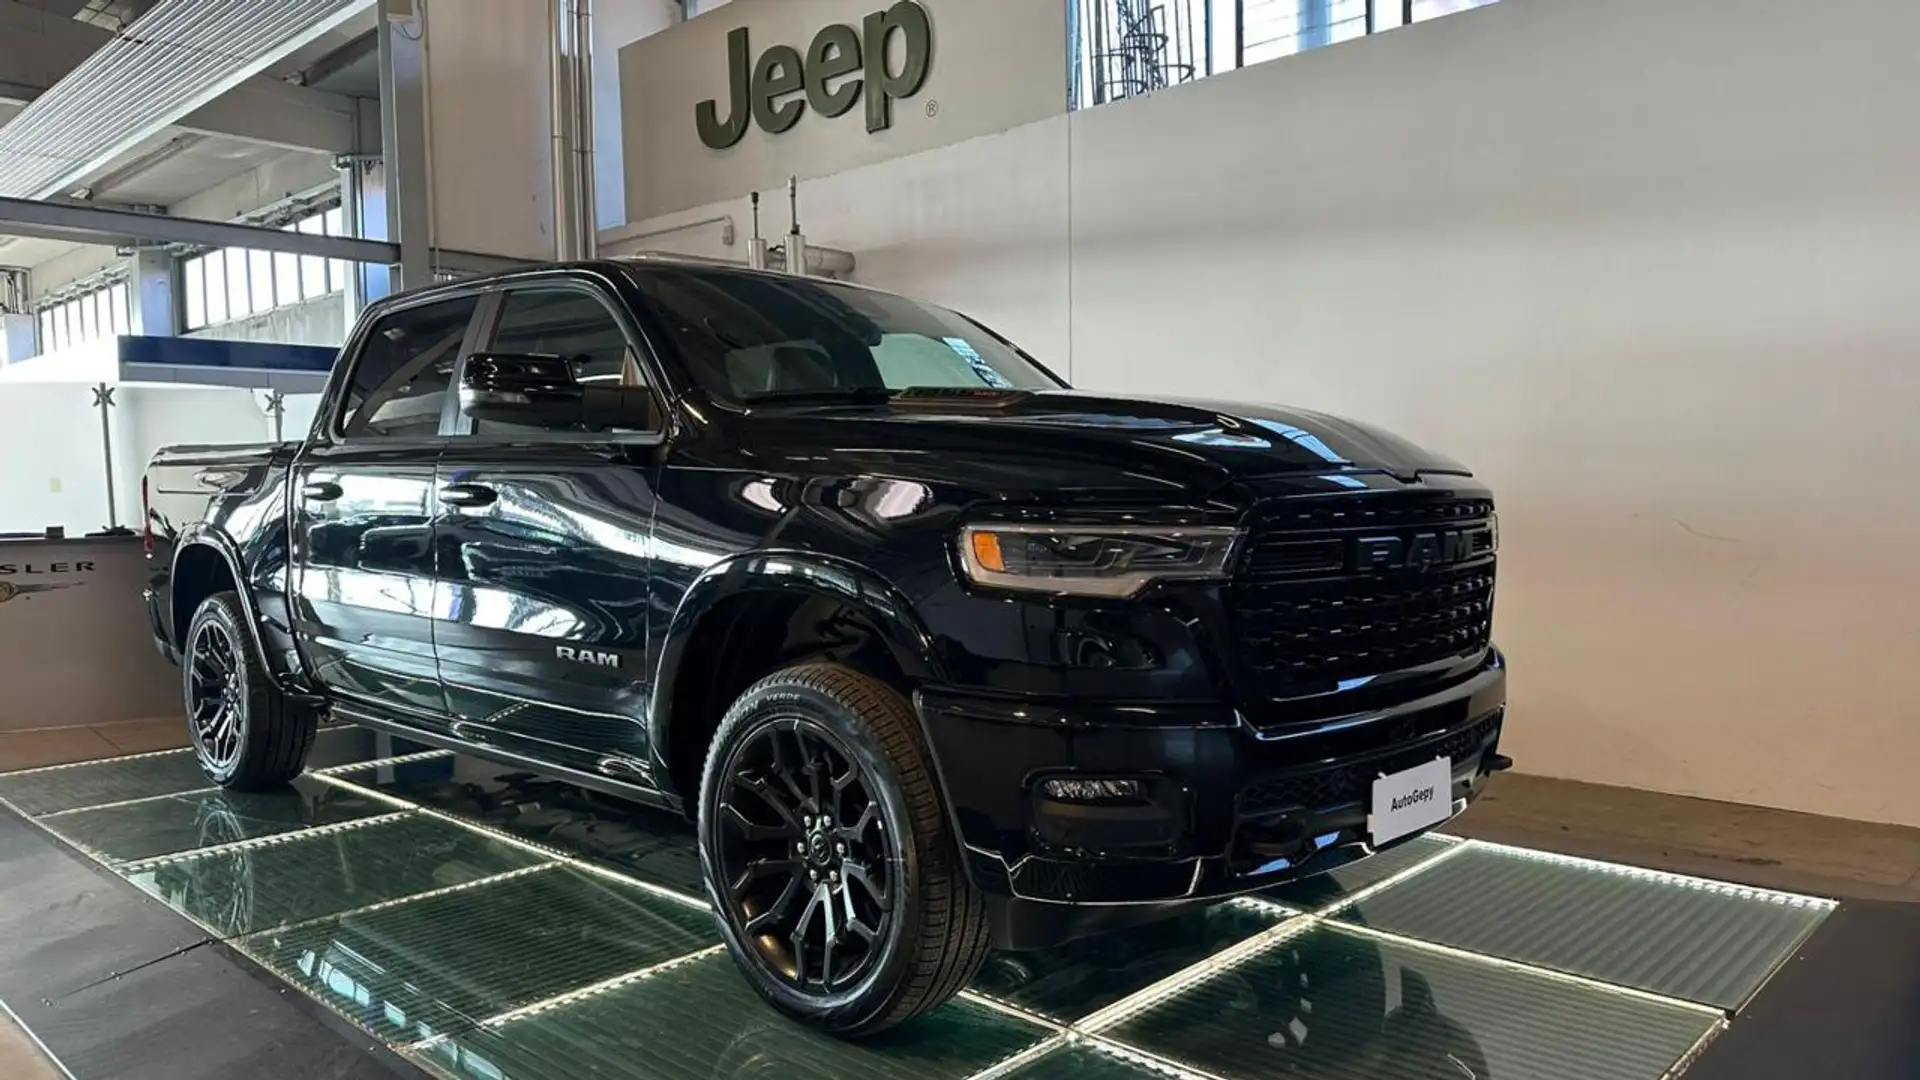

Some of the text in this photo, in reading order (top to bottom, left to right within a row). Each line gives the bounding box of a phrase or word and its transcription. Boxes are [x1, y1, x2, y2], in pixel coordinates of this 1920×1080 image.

[696, 0, 932, 149] Jeep
[1357, 530, 1474, 570] RAM
[0, 561, 96, 574] SLER
[555, 646, 619, 668] RAM
[765, 692, 801, 701] VERDE
[1390, 785, 1435, 812] AutoGepy
